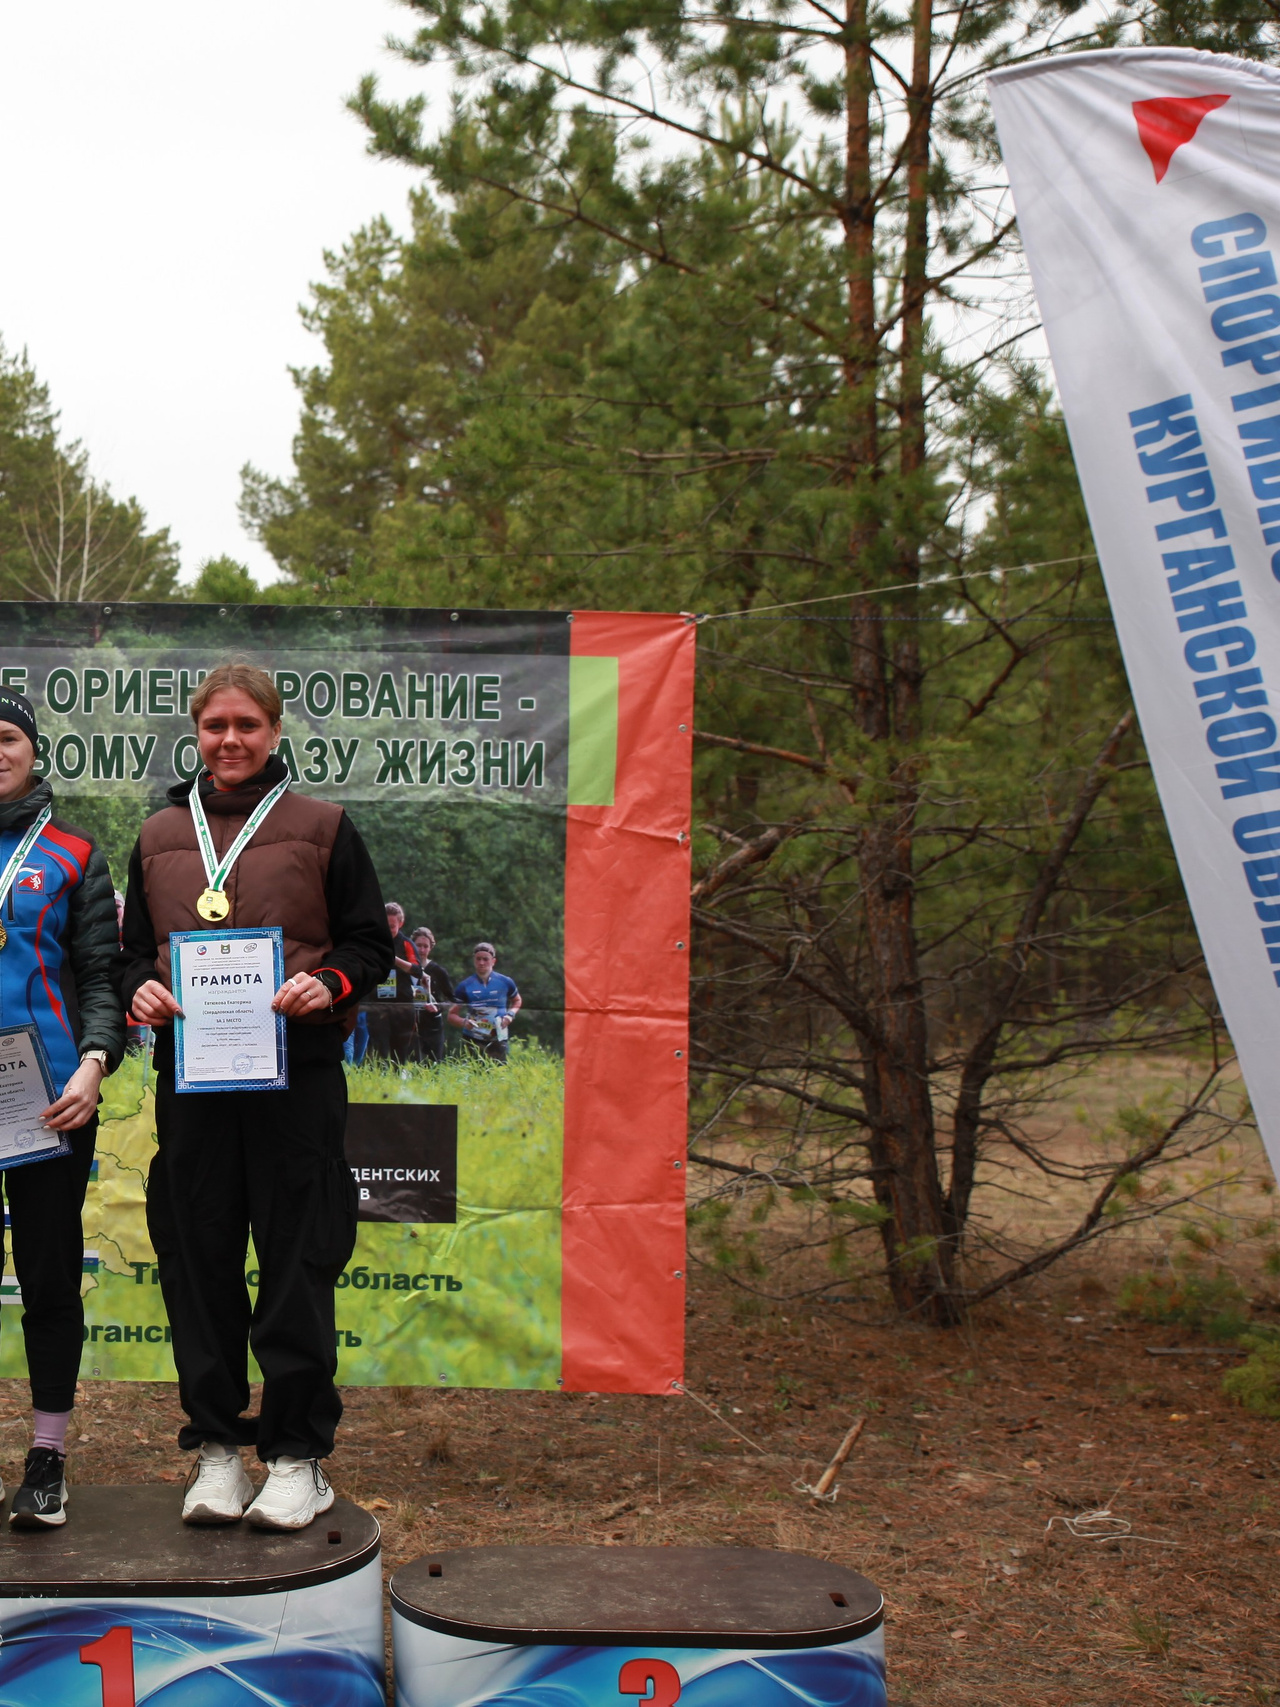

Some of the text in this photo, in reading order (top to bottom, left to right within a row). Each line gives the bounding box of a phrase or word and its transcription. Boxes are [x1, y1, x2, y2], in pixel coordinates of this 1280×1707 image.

[46, 667, 502, 722] ОРИЕНРОВАНИЕ
[172, 734, 360, 785] ОАЗУ
[375, 738, 545, 788] ЖИЗНИ
[191, 973, 263, 987] ГРАМОТА
[350, 1167, 440, 1182] ДЕНТСКИХ
[334, 1265, 463, 1292] область
[79, 1626, 136, 1707] 1
